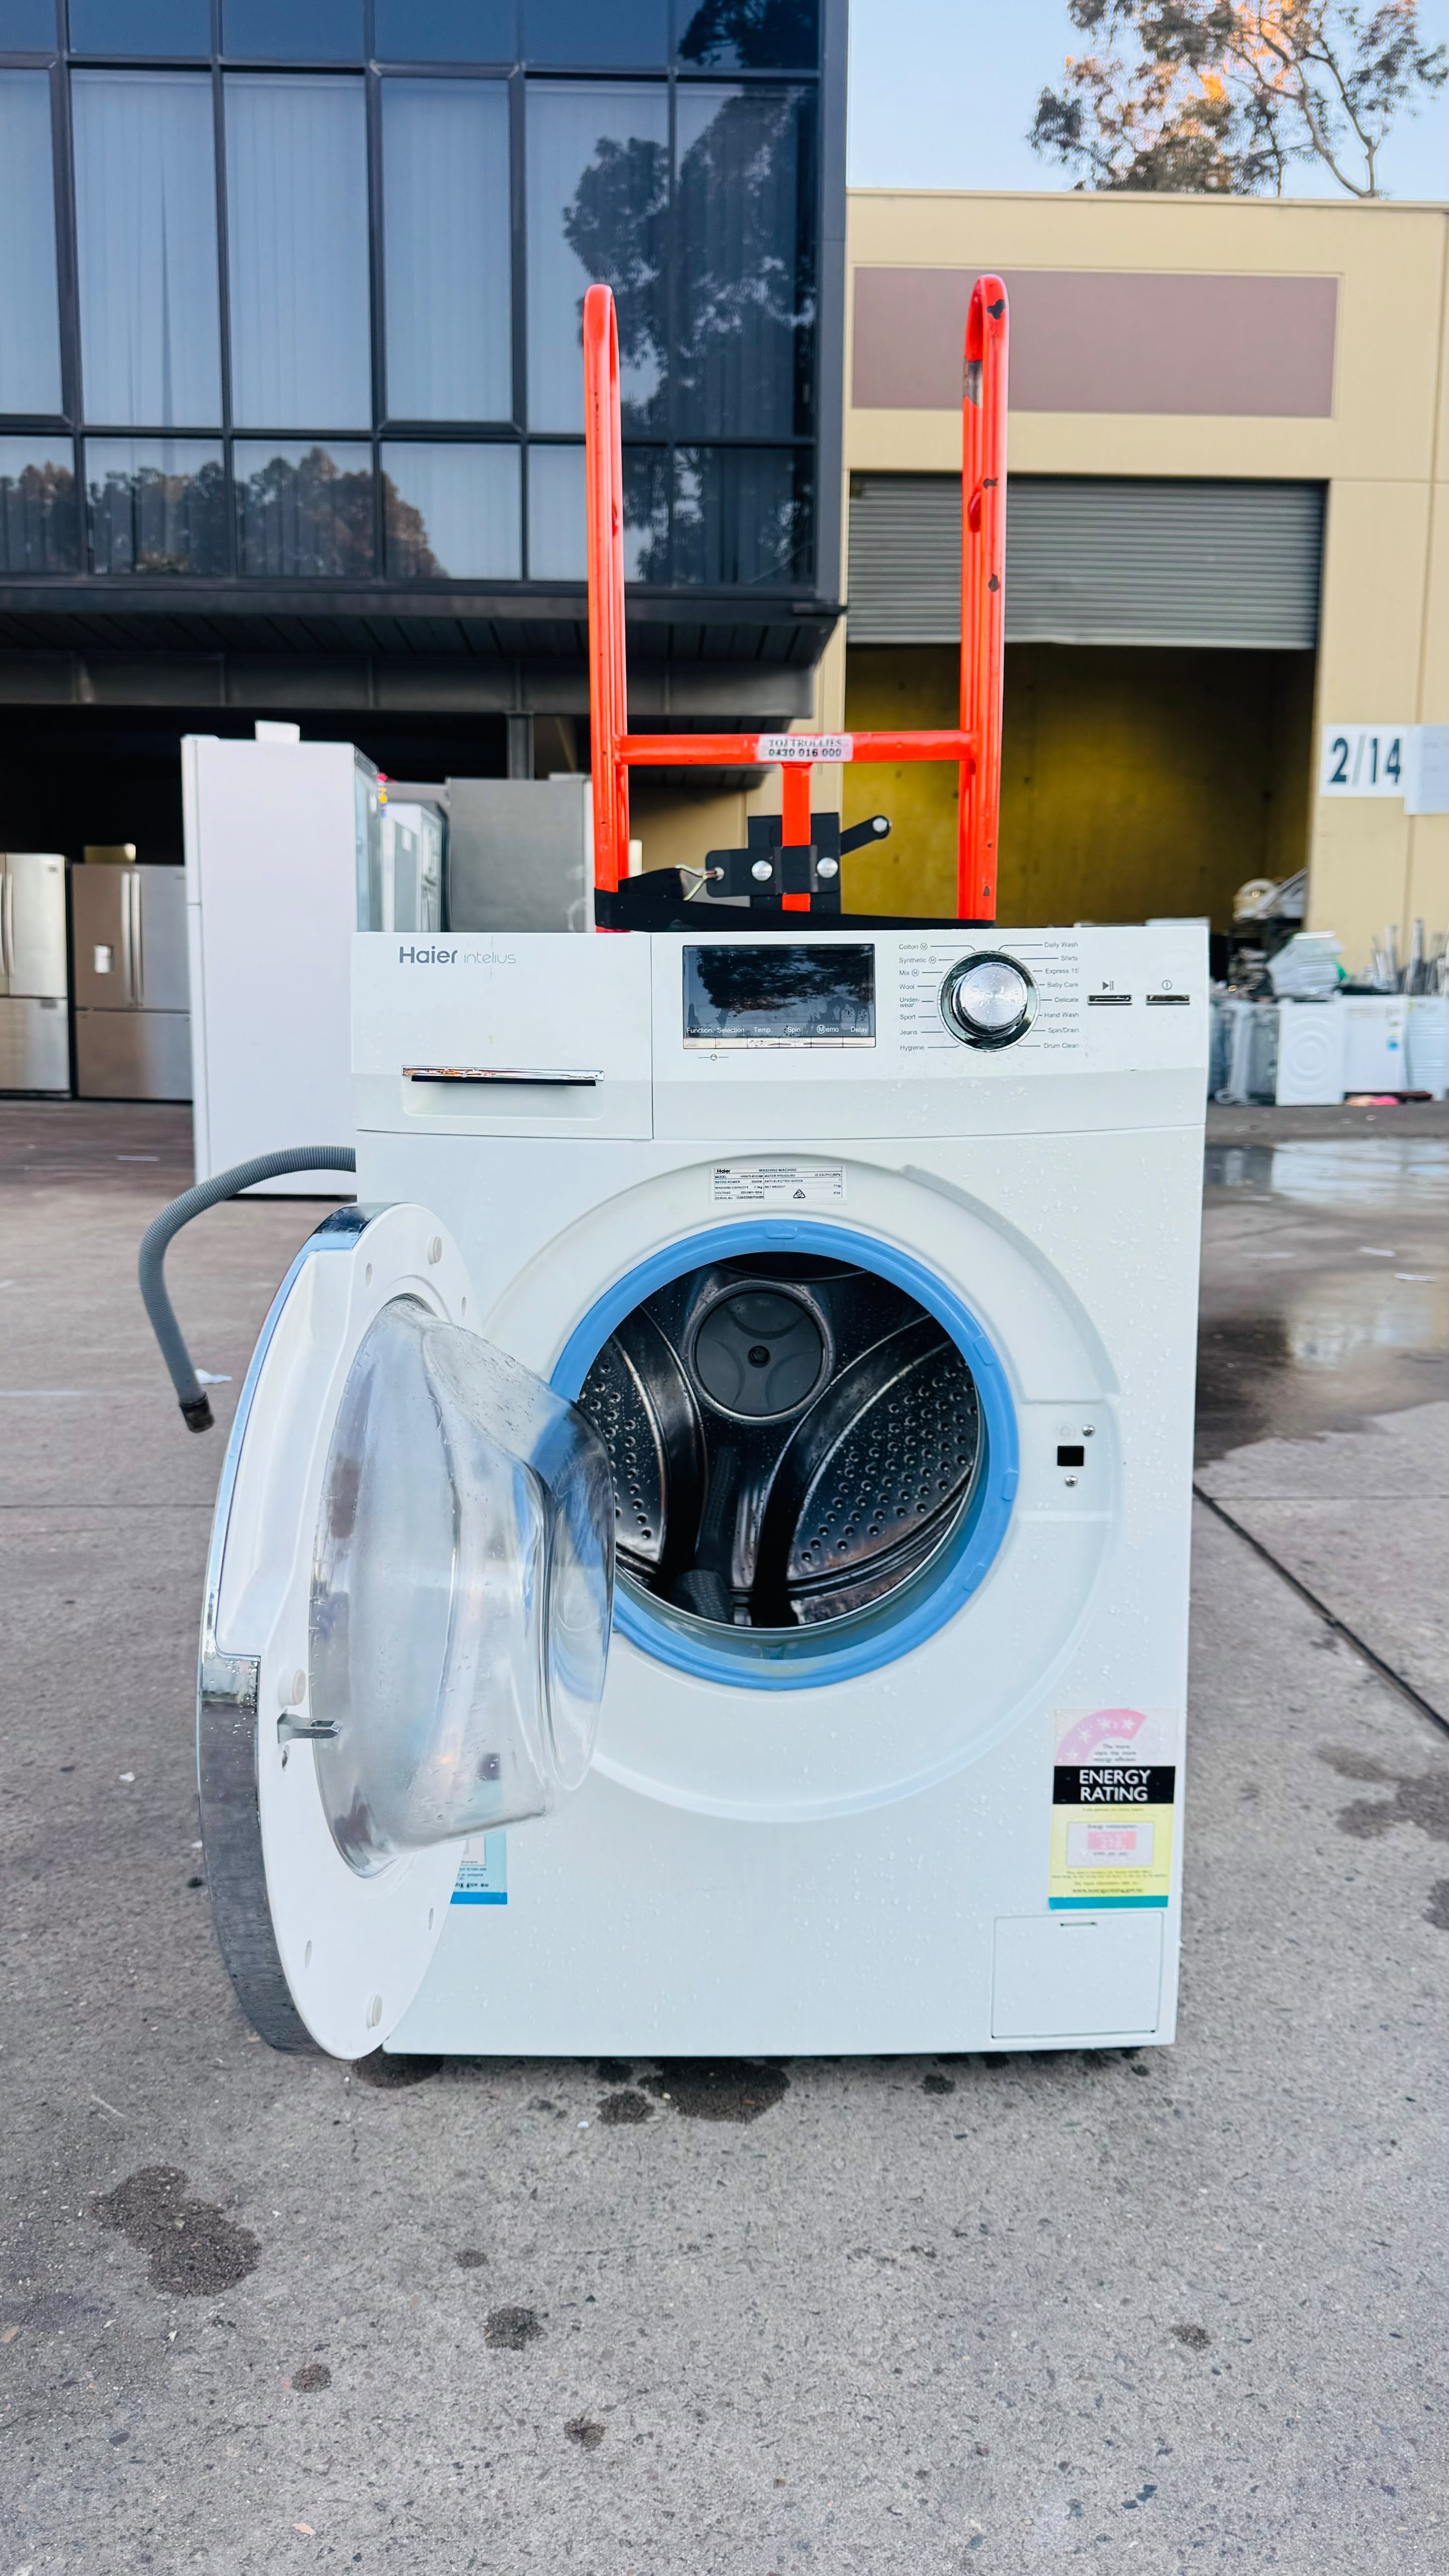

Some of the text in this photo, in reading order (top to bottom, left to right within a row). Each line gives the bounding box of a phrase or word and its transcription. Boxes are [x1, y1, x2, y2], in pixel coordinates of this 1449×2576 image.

[769, 749, 841, 757] 0430 016 000
[1329, 735, 1401, 786] 2/14
[399, 946, 516, 963] Haier intelius
[1079, 1769, 1151, 1785] ENERGY
[1080, 1787, 1148, 1802] RATING
